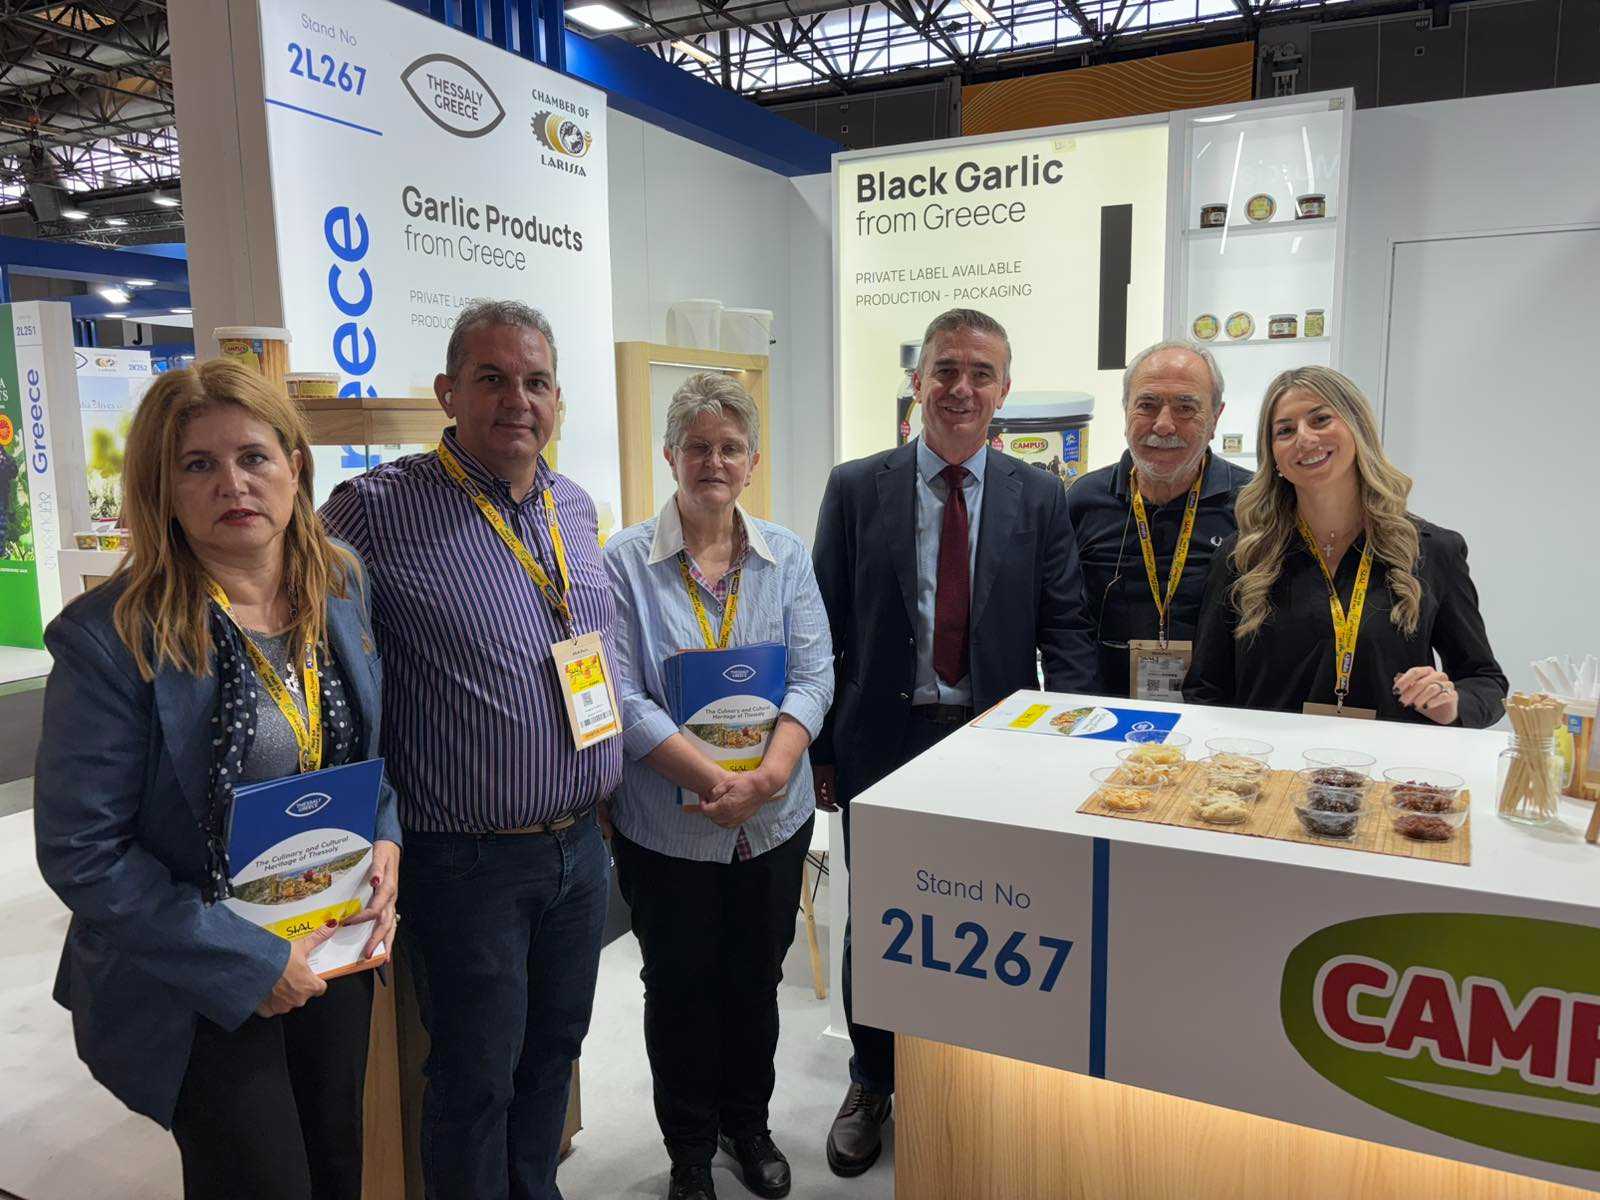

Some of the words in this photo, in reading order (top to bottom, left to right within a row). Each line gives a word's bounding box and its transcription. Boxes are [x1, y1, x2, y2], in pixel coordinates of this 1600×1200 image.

[301, 13, 336, 41] Stand
[340, 27, 358, 47] No
[287, 42, 367, 97] 2L267
[426, 74, 484, 107] THESSALY
[531, 88, 577, 115] CHAMBER
[578, 107, 590, 119] OF
[434, 94, 480, 121] GREECE
[541, 154, 587, 177] LARISSA
[857, 166, 948, 203] Black
[955, 154, 1064, 193] Garlic
[402, 186, 481, 231] Garlic
[487, 205, 583, 252] Products
[856, 210, 916, 236] from
[924, 201, 1026, 230] Greece
[404, 224, 455, 258] from
[458, 236, 527, 271] Greece
[856, 269, 906, 285] PRIVATE
[909, 266, 948, 281] LABEL
[952, 260, 1022, 277] AVAILABLE
[409, 289, 451, 307] PRIVATE
[856, 289, 940, 306] PRODUCTION
[954, 283, 1033, 301] PACKAGING
[16, 325, 37, 337] 2L251
[132, 323, 143, 346] J
[27, 368, 48, 475] Greece
[1012, 441, 1046, 449] CAMPUS
[256, 860, 269, 869] The
[272, 849, 303, 863] Culinary
[305, 843, 319, 853] and
[321, 835, 349, 848] Cultural
[264, 858, 297, 872] Heritage
[299, 854, 307, 862] of
[309, 846, 339, 859] Thessaly
[915, 868, 984, 902] Stand
[995, 881, 1032, 911] No
[881, 906, 1074, 994] 2L267
